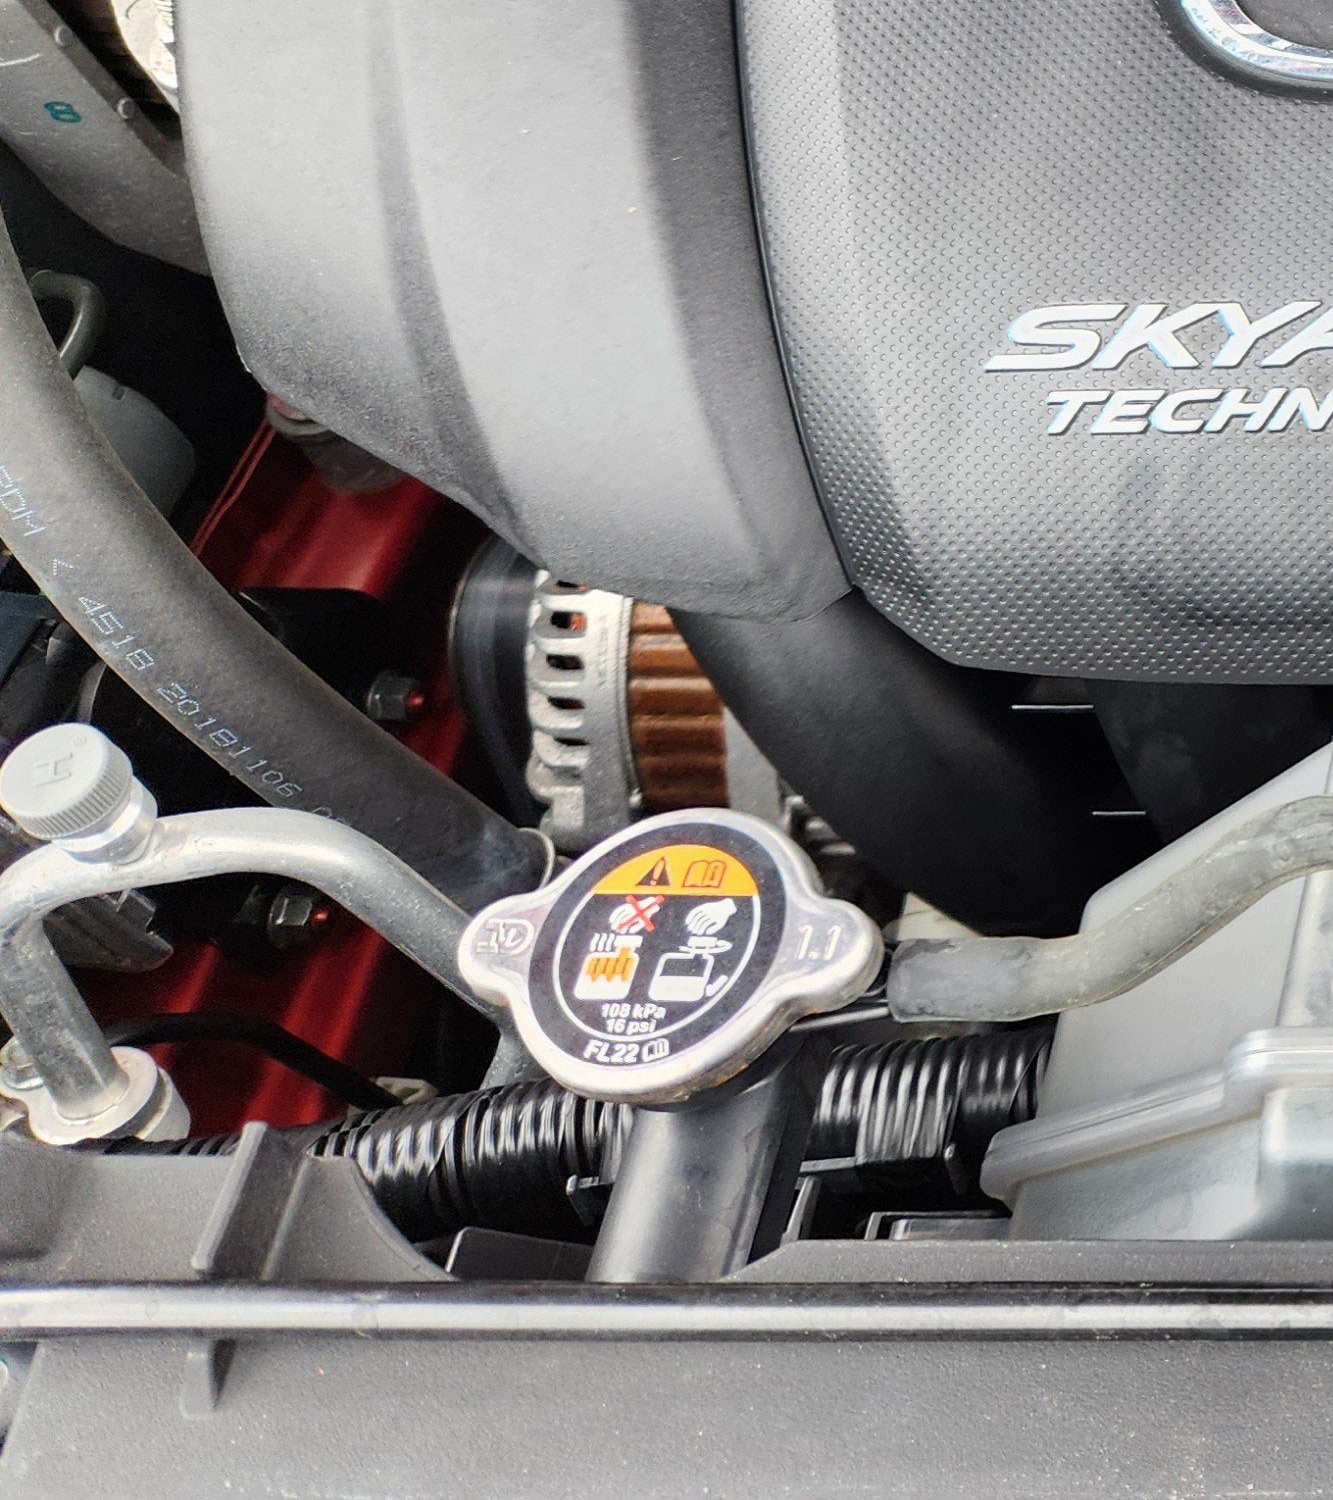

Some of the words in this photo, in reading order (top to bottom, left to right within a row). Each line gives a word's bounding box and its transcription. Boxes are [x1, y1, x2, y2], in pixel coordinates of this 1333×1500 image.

[157, 681, 303, 798] 20181106
[795, 923, 843, 962] 1.1
[600, 1002, 632, 1018] 108
[631, 1002, 667, 1019] kPa
[605, 1018, 627, 1034] 16
[626, 1018, 657, 1036] psi
[583, 1039, 641, 1063] FL22
